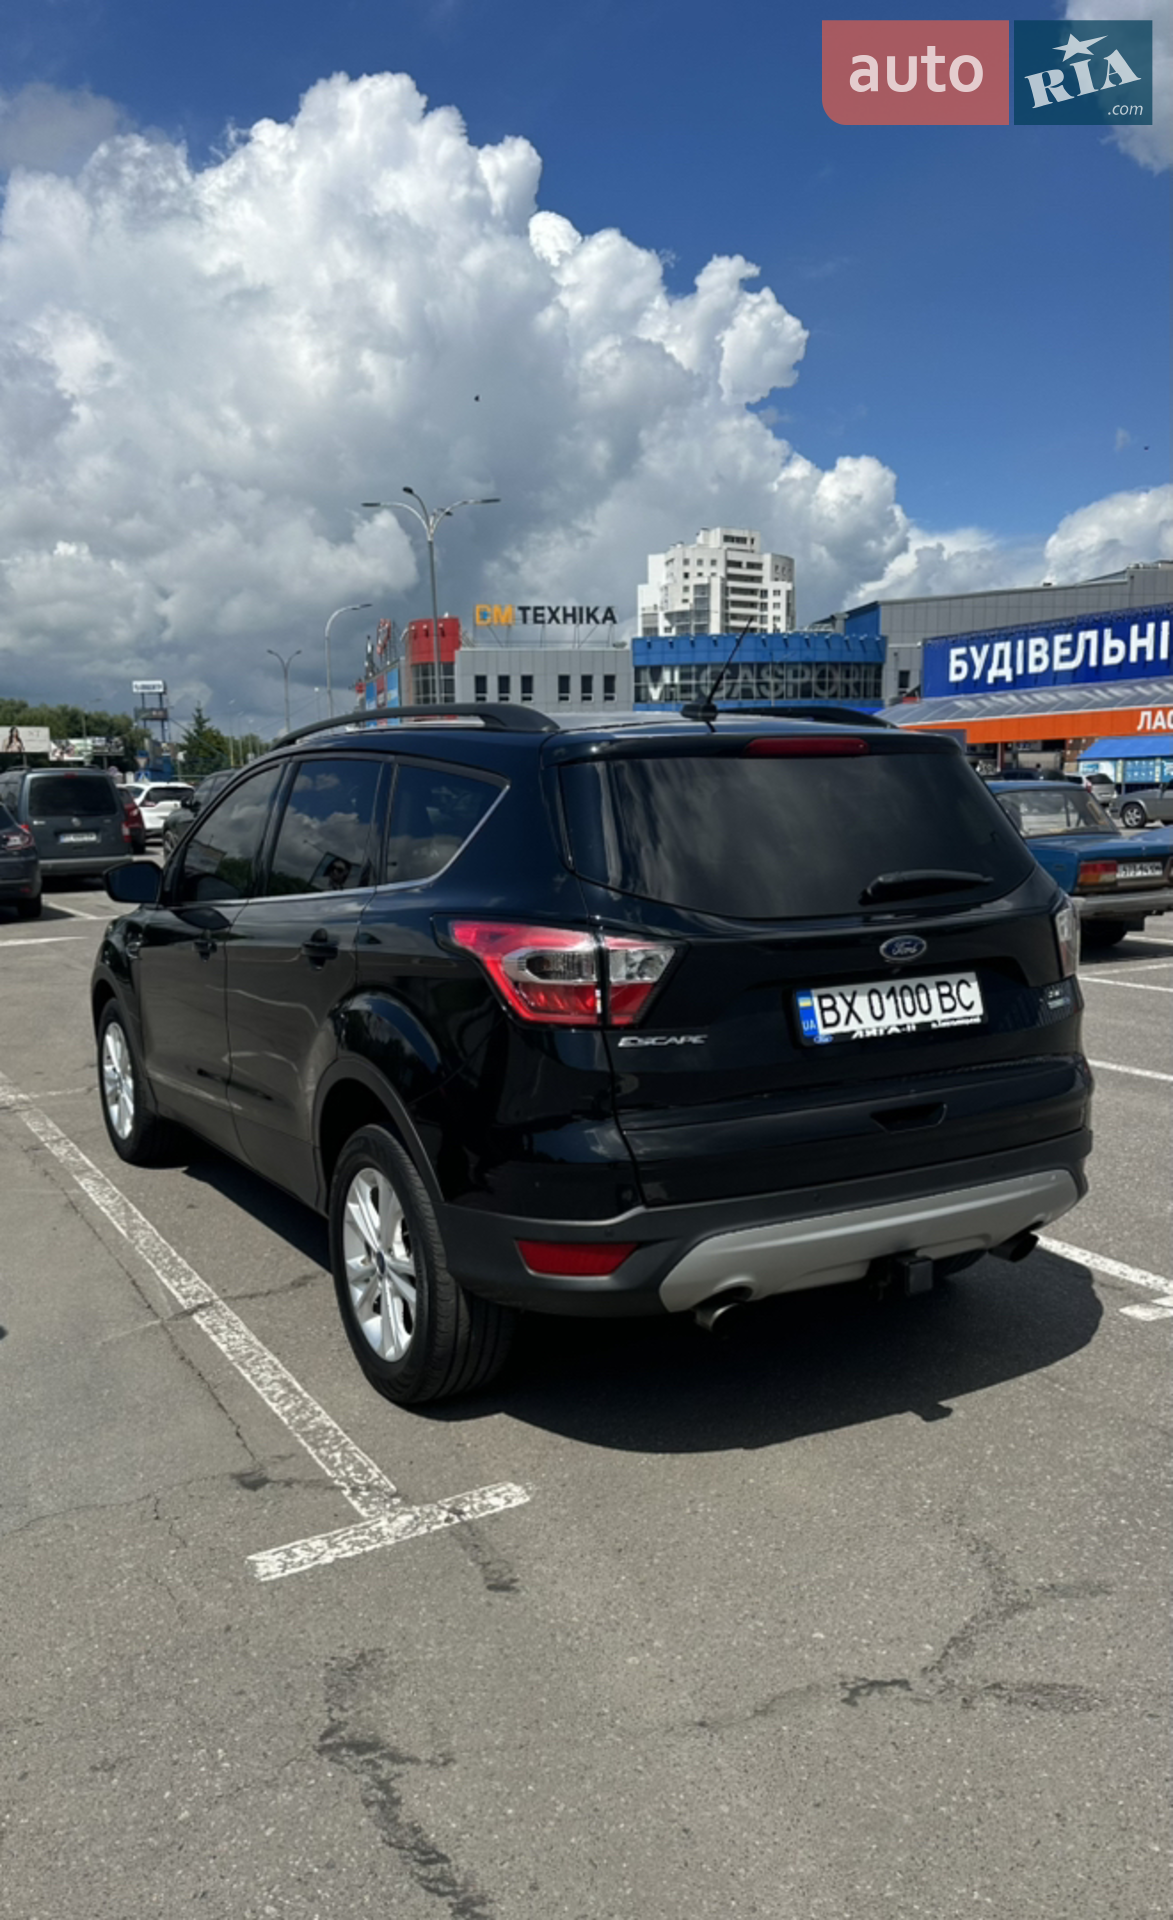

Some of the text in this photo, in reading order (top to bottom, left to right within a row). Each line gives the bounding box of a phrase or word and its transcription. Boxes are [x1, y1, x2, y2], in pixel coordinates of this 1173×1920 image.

[518, 606, 617, 624] ТЕХНІКА
[948, 620, 1170, 684] БУДІВЕЛЬНІ
[867, 983, 932, 1021] 0100
[803, 1019, 817, 1031] UA
